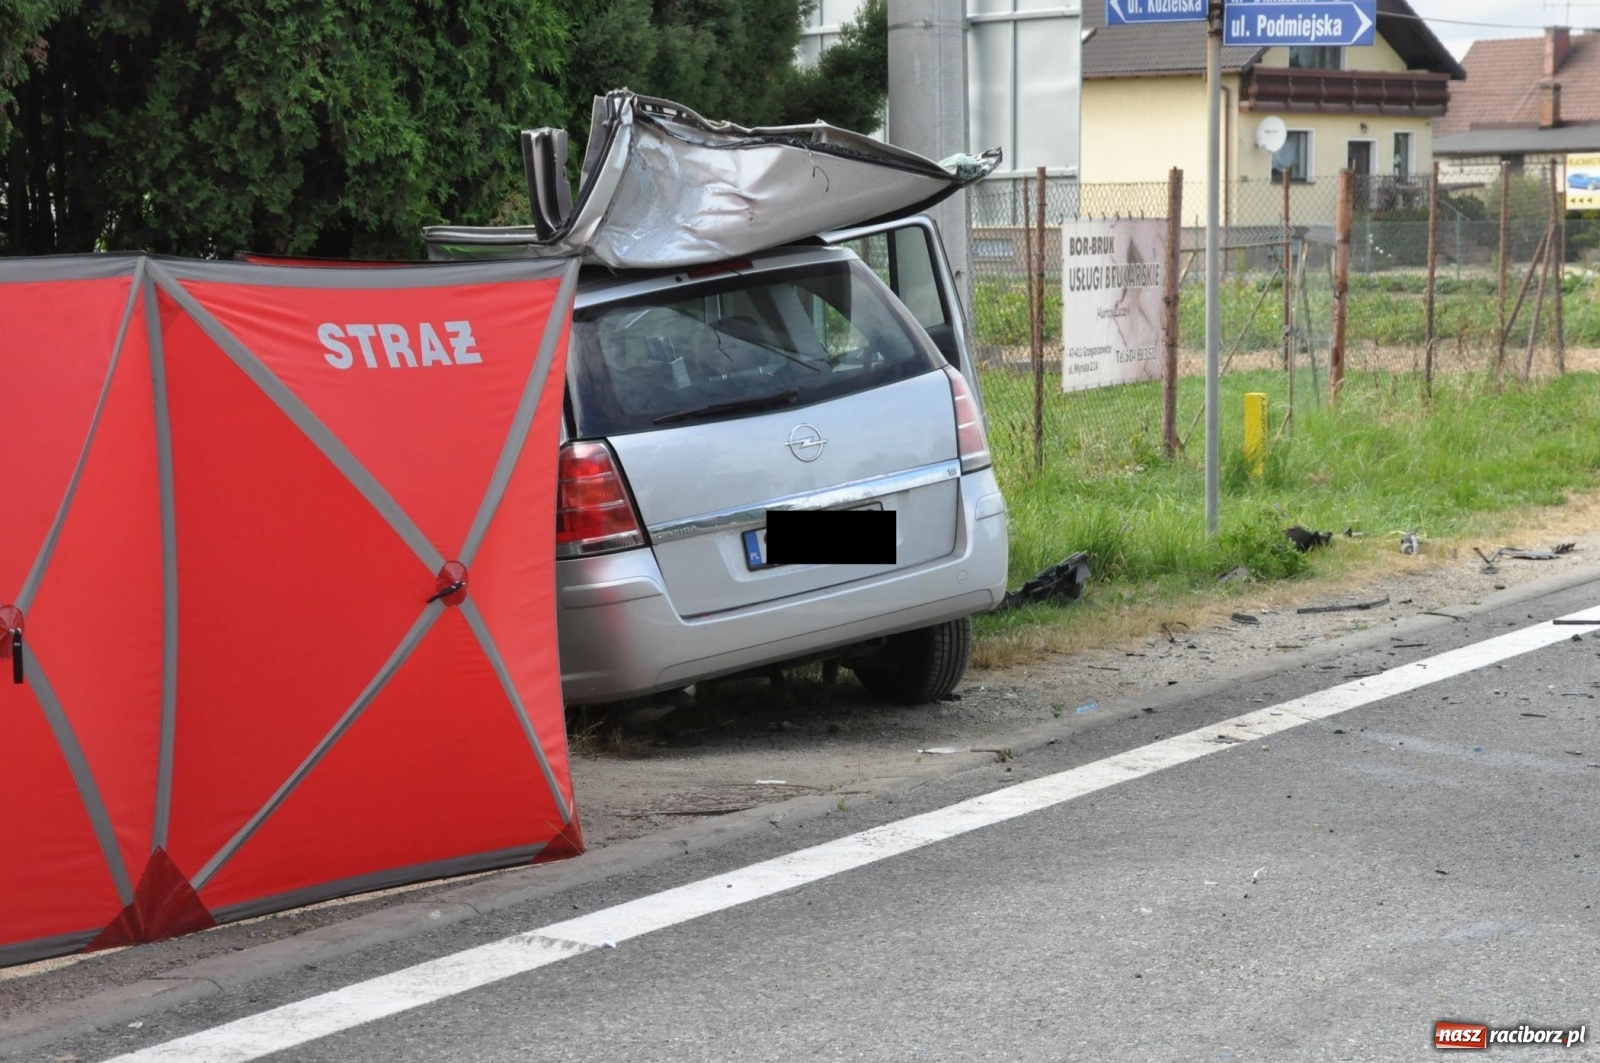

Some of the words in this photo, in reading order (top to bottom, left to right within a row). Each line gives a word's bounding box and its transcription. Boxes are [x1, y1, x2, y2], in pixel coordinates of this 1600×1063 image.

[1231, 14, 1250, 38] ul.
[1256, 13, 1342, 42] Podmiejska
[1069, 235, 1115, 256] BOR-BRUK
[1069, 265, 1103, 292] USŁUGI
[1105, 263, 1160, 289] BRUKARSKIE
[750, 552, 760, 561] PL
